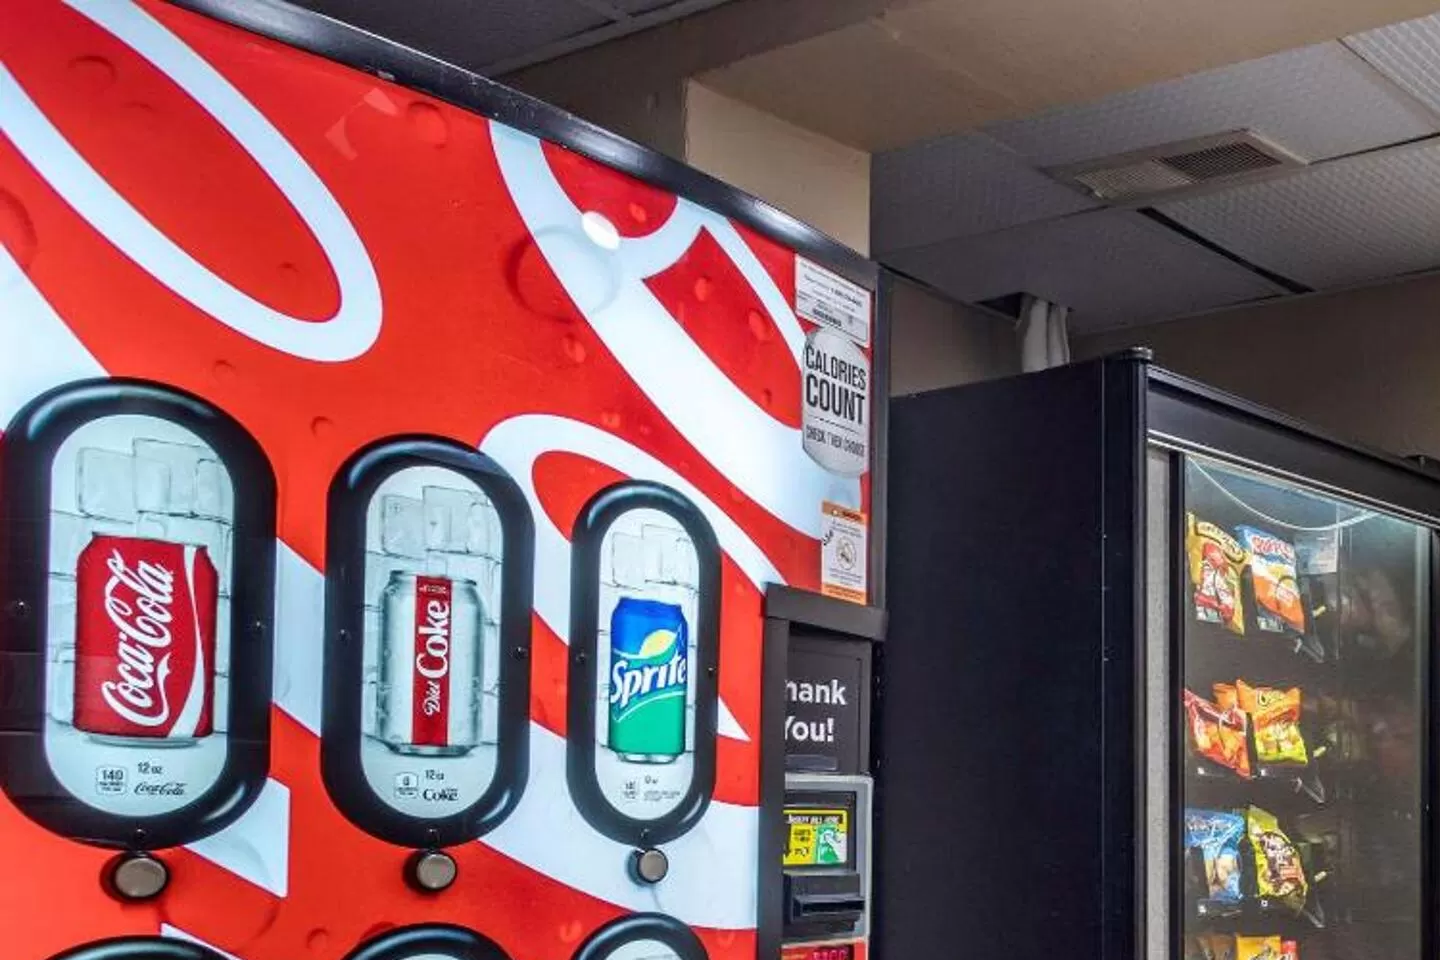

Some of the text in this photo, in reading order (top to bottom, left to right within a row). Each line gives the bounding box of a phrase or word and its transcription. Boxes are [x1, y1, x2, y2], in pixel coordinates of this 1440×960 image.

[805, 343, 867, 391] CALORIES
[805, 372, 866, 425] COUNT
[415, 599, 450, 679] Coke
[422, 680, 442, 716] Diet
[609, 648, 687, 709] Sprite
[784, 678, 848, 706] hank
[102, 769, 124, 781] 140
[137, 761, 150, 775] 12
